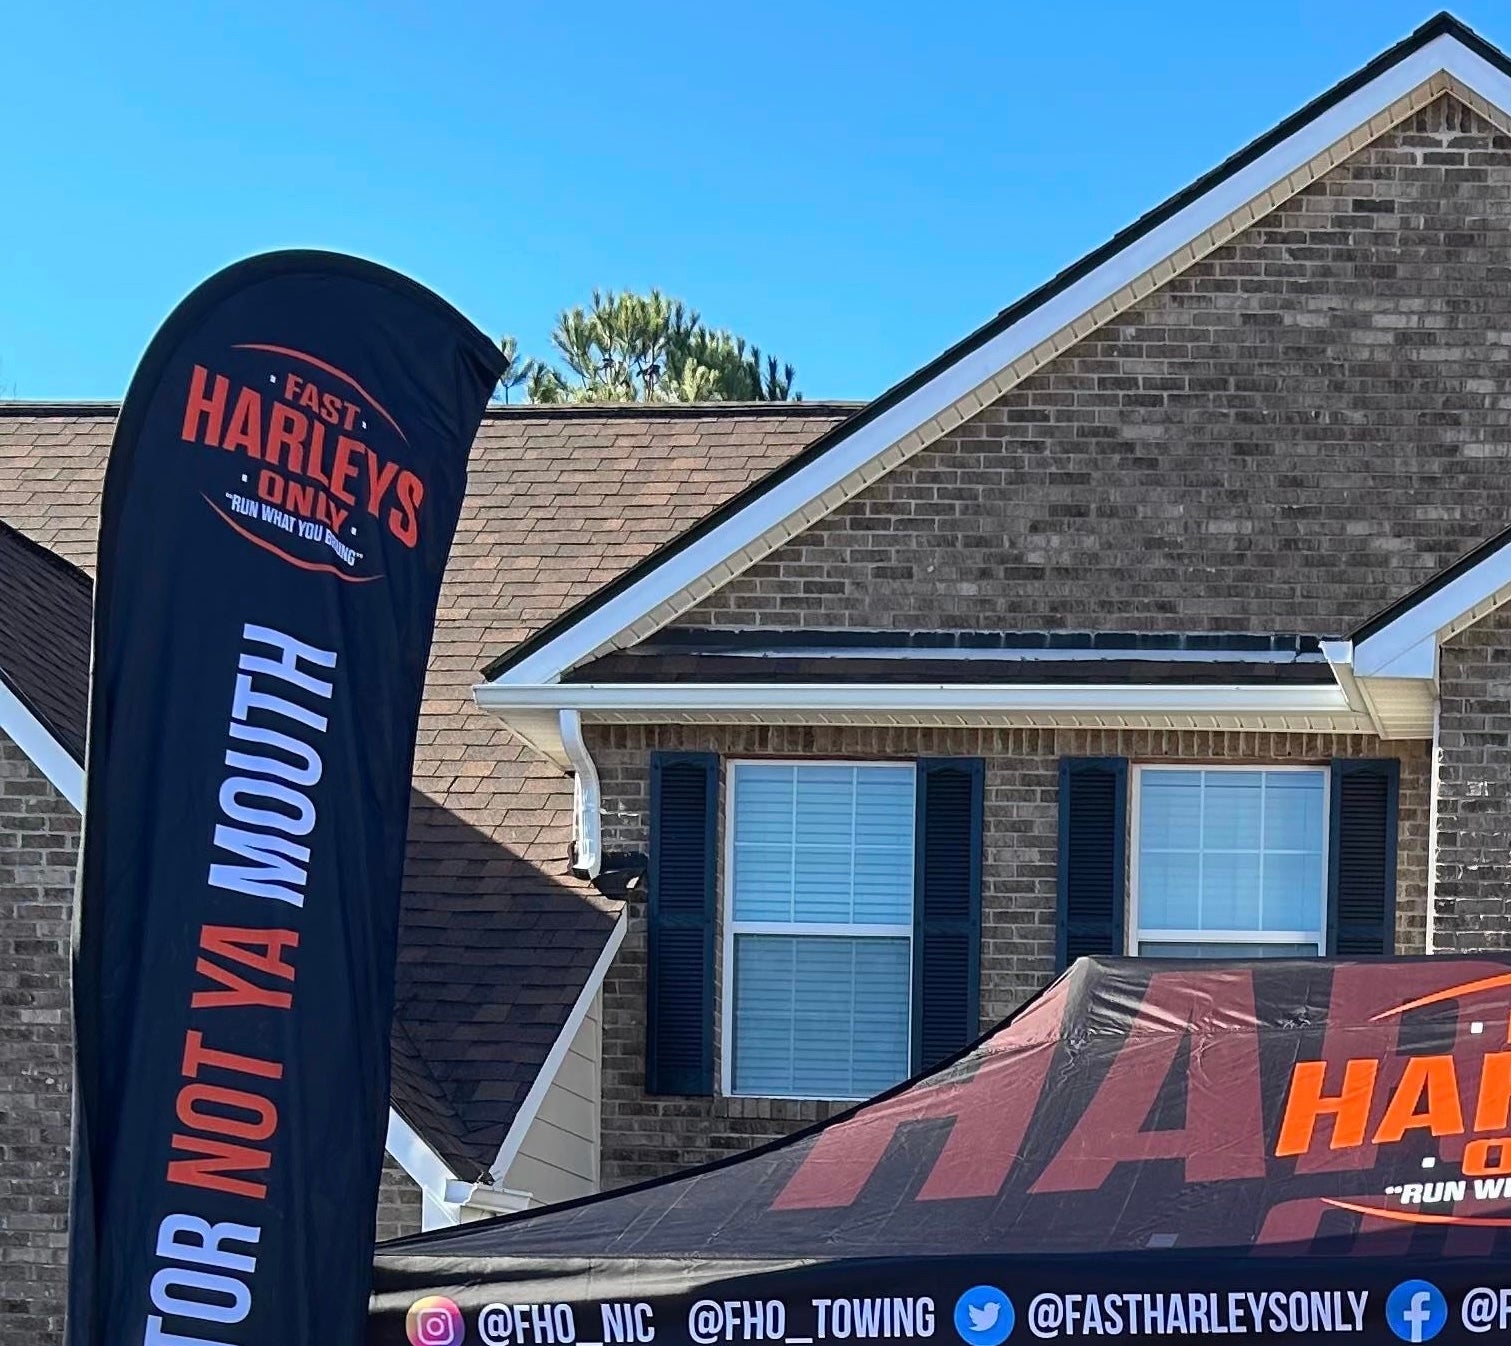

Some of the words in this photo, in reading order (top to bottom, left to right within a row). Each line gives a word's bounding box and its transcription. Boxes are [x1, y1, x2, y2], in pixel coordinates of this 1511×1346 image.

[284, 372, 361, 431] FAST
[181, 364, 424, 548] HARLEYS
[258, 469, 348, 534] ONLY
[262, 504, 296, 533] WHAT
[296, 519, 323, 541] YOU
[207, 624, 338, 908] MOUTH
[190, 924, 300, 1009] YA
[167, 1029, 284, 1200] NOT
[688, 1297, 935, 1345] @FHO_TOWING
[1028, 1290, 1368, 1339] @FASTHARLEYSONLY
